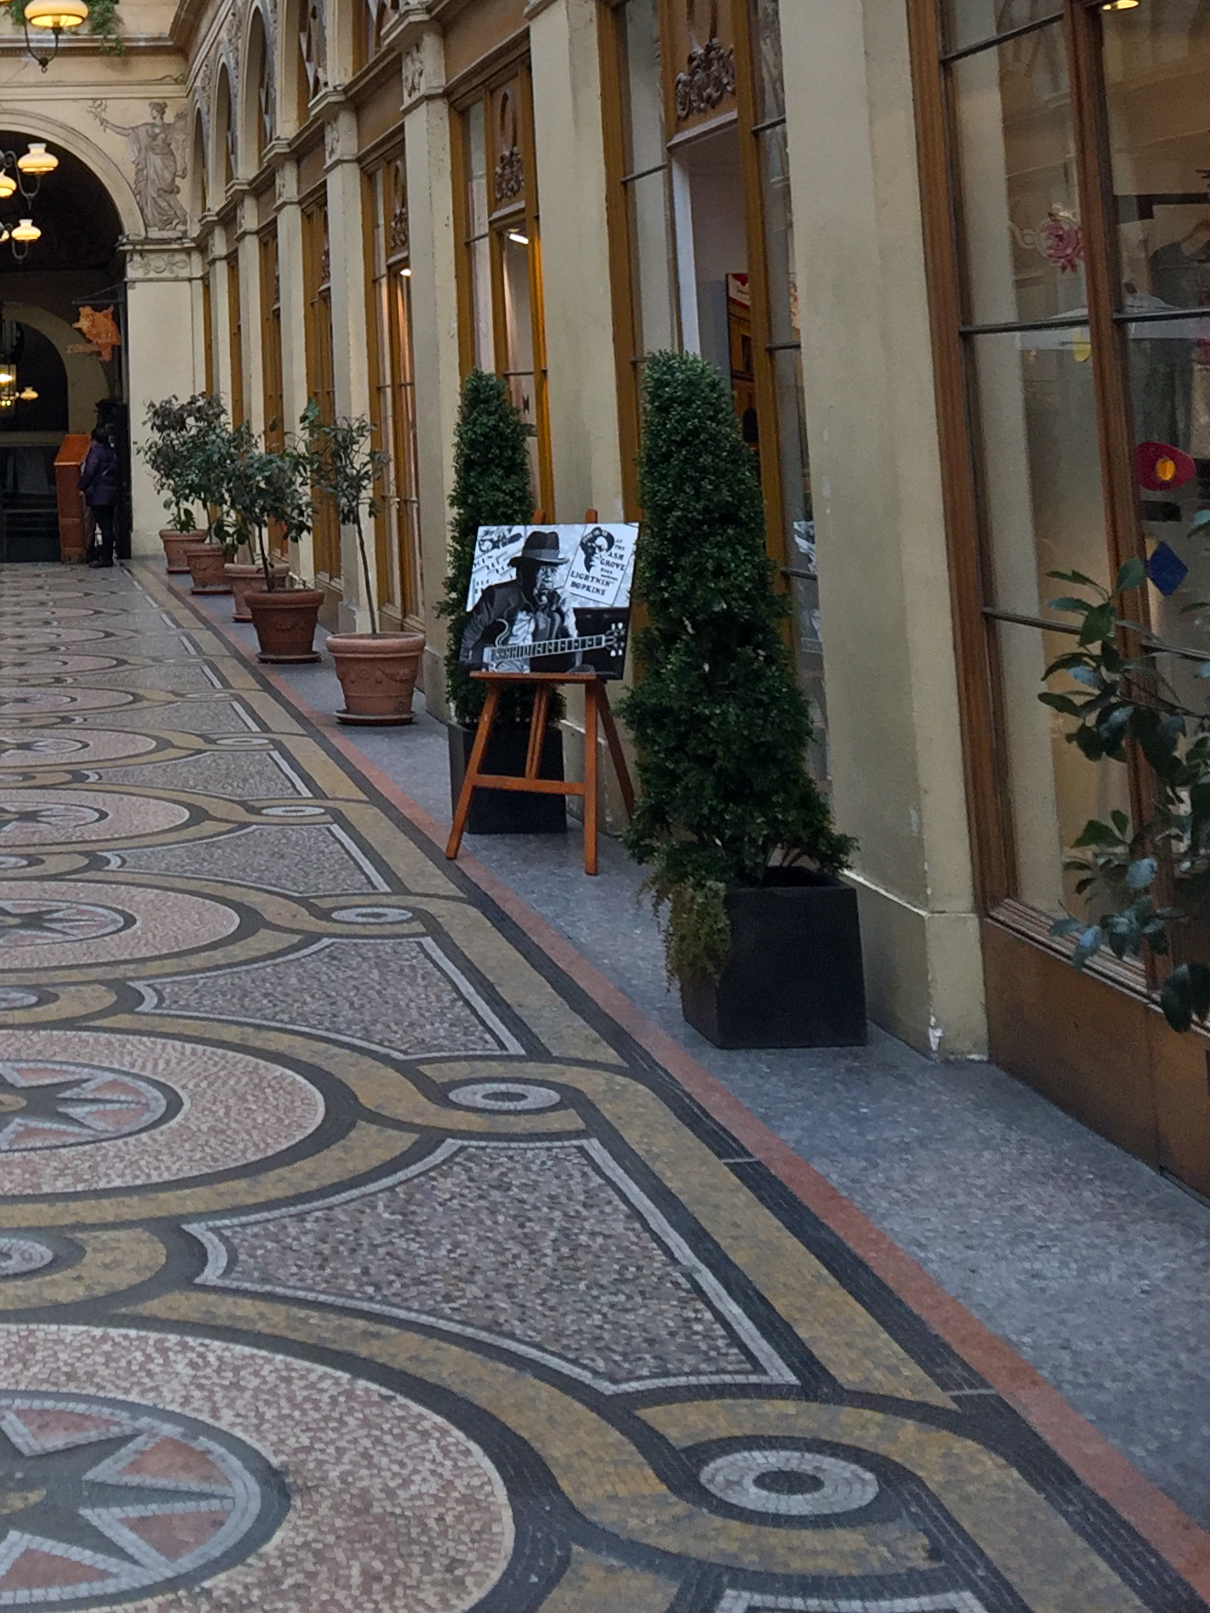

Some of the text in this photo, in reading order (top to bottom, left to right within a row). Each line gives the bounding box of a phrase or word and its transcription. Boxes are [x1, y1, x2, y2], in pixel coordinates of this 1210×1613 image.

[608, 552, 624, 560] ASH
[600, 558, 625, 570] GROVE
[570, 581, 606, 595] HOPKINS
